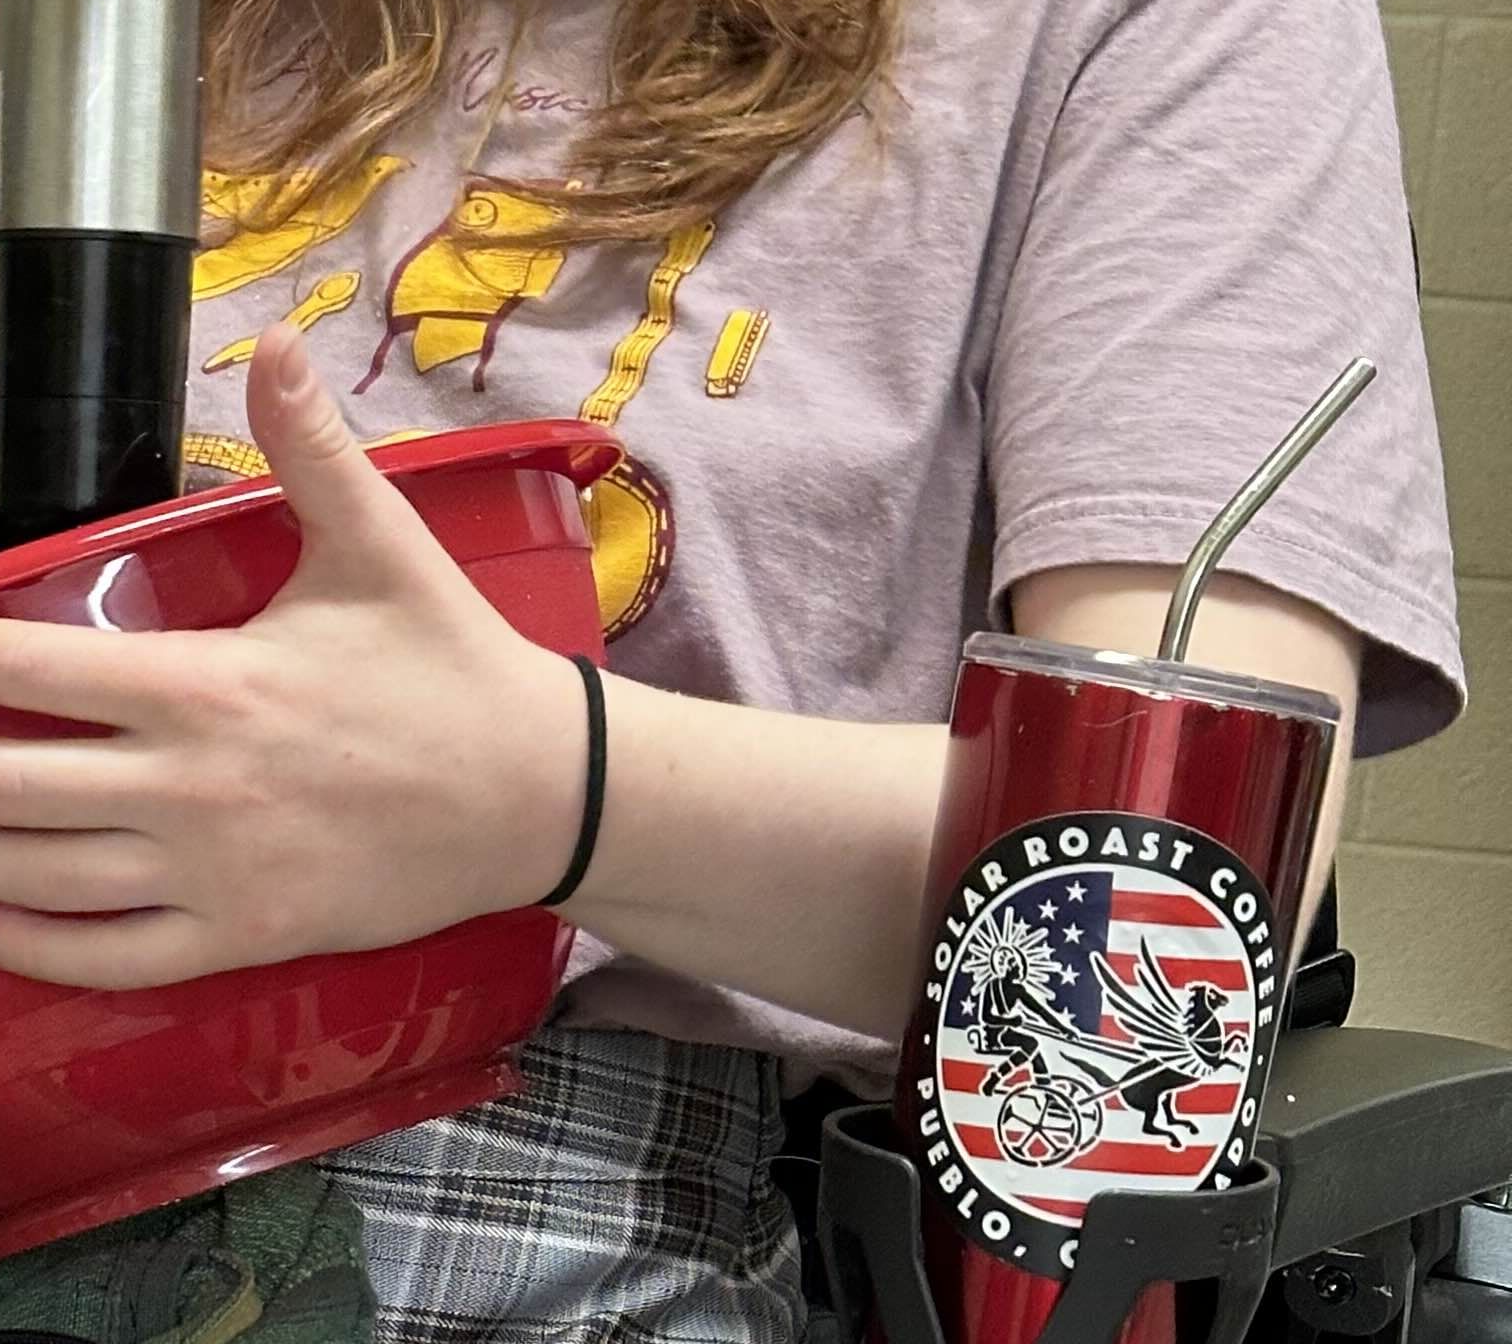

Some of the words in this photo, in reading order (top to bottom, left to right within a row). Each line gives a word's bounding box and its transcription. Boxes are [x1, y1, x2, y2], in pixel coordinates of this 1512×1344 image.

[926, 861, 1008, 1003] SOLAR
[1023, 826, 1194, 871] ROAST
[1210, 867, 1276, 1028] COFFEE
